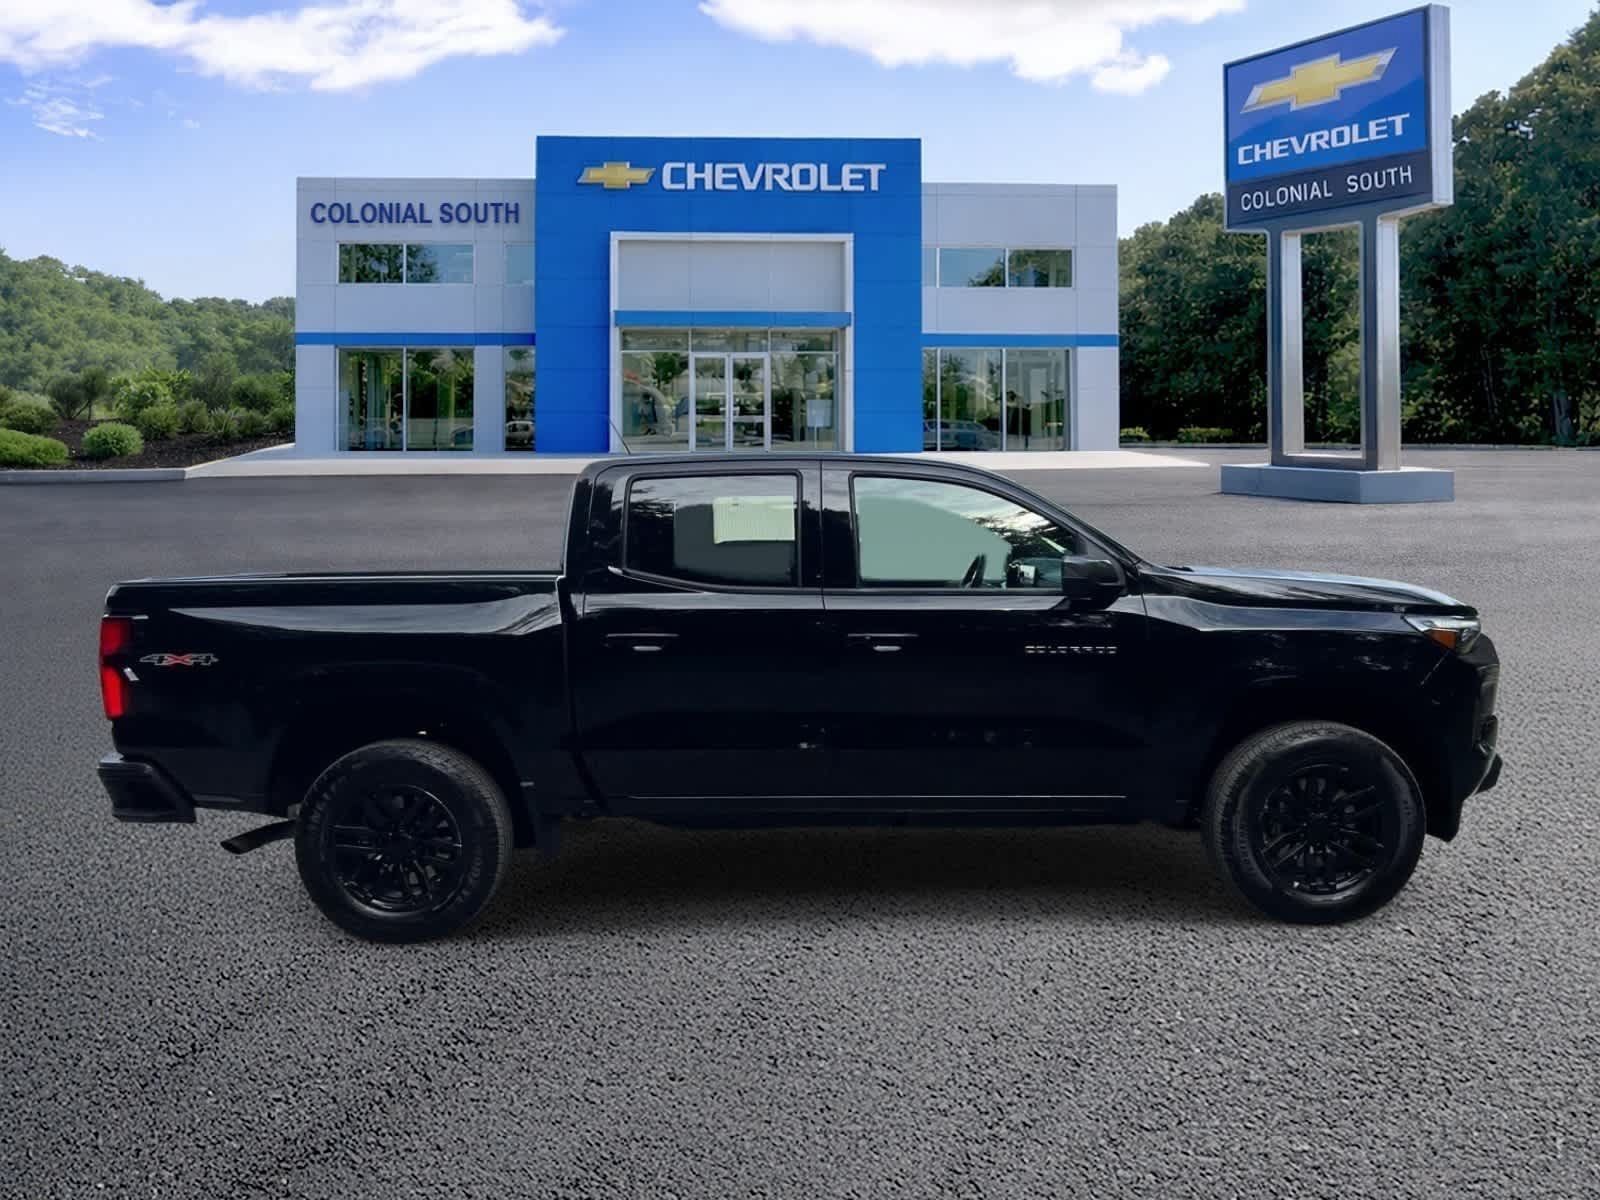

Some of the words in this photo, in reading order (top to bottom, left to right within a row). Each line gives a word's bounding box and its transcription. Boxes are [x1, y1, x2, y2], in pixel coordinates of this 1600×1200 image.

[1237, 113, 1410, 165] CHEVROLET
[661, 161, 887, 193] CHEVROLET
[1241, 180, 1333, 211] COLONIAL
[1346, 165, 1413, 193] SOUTH
[310, 202, 433, 225] COLONIAL
[439, 201, 520, 224] SOUTH
